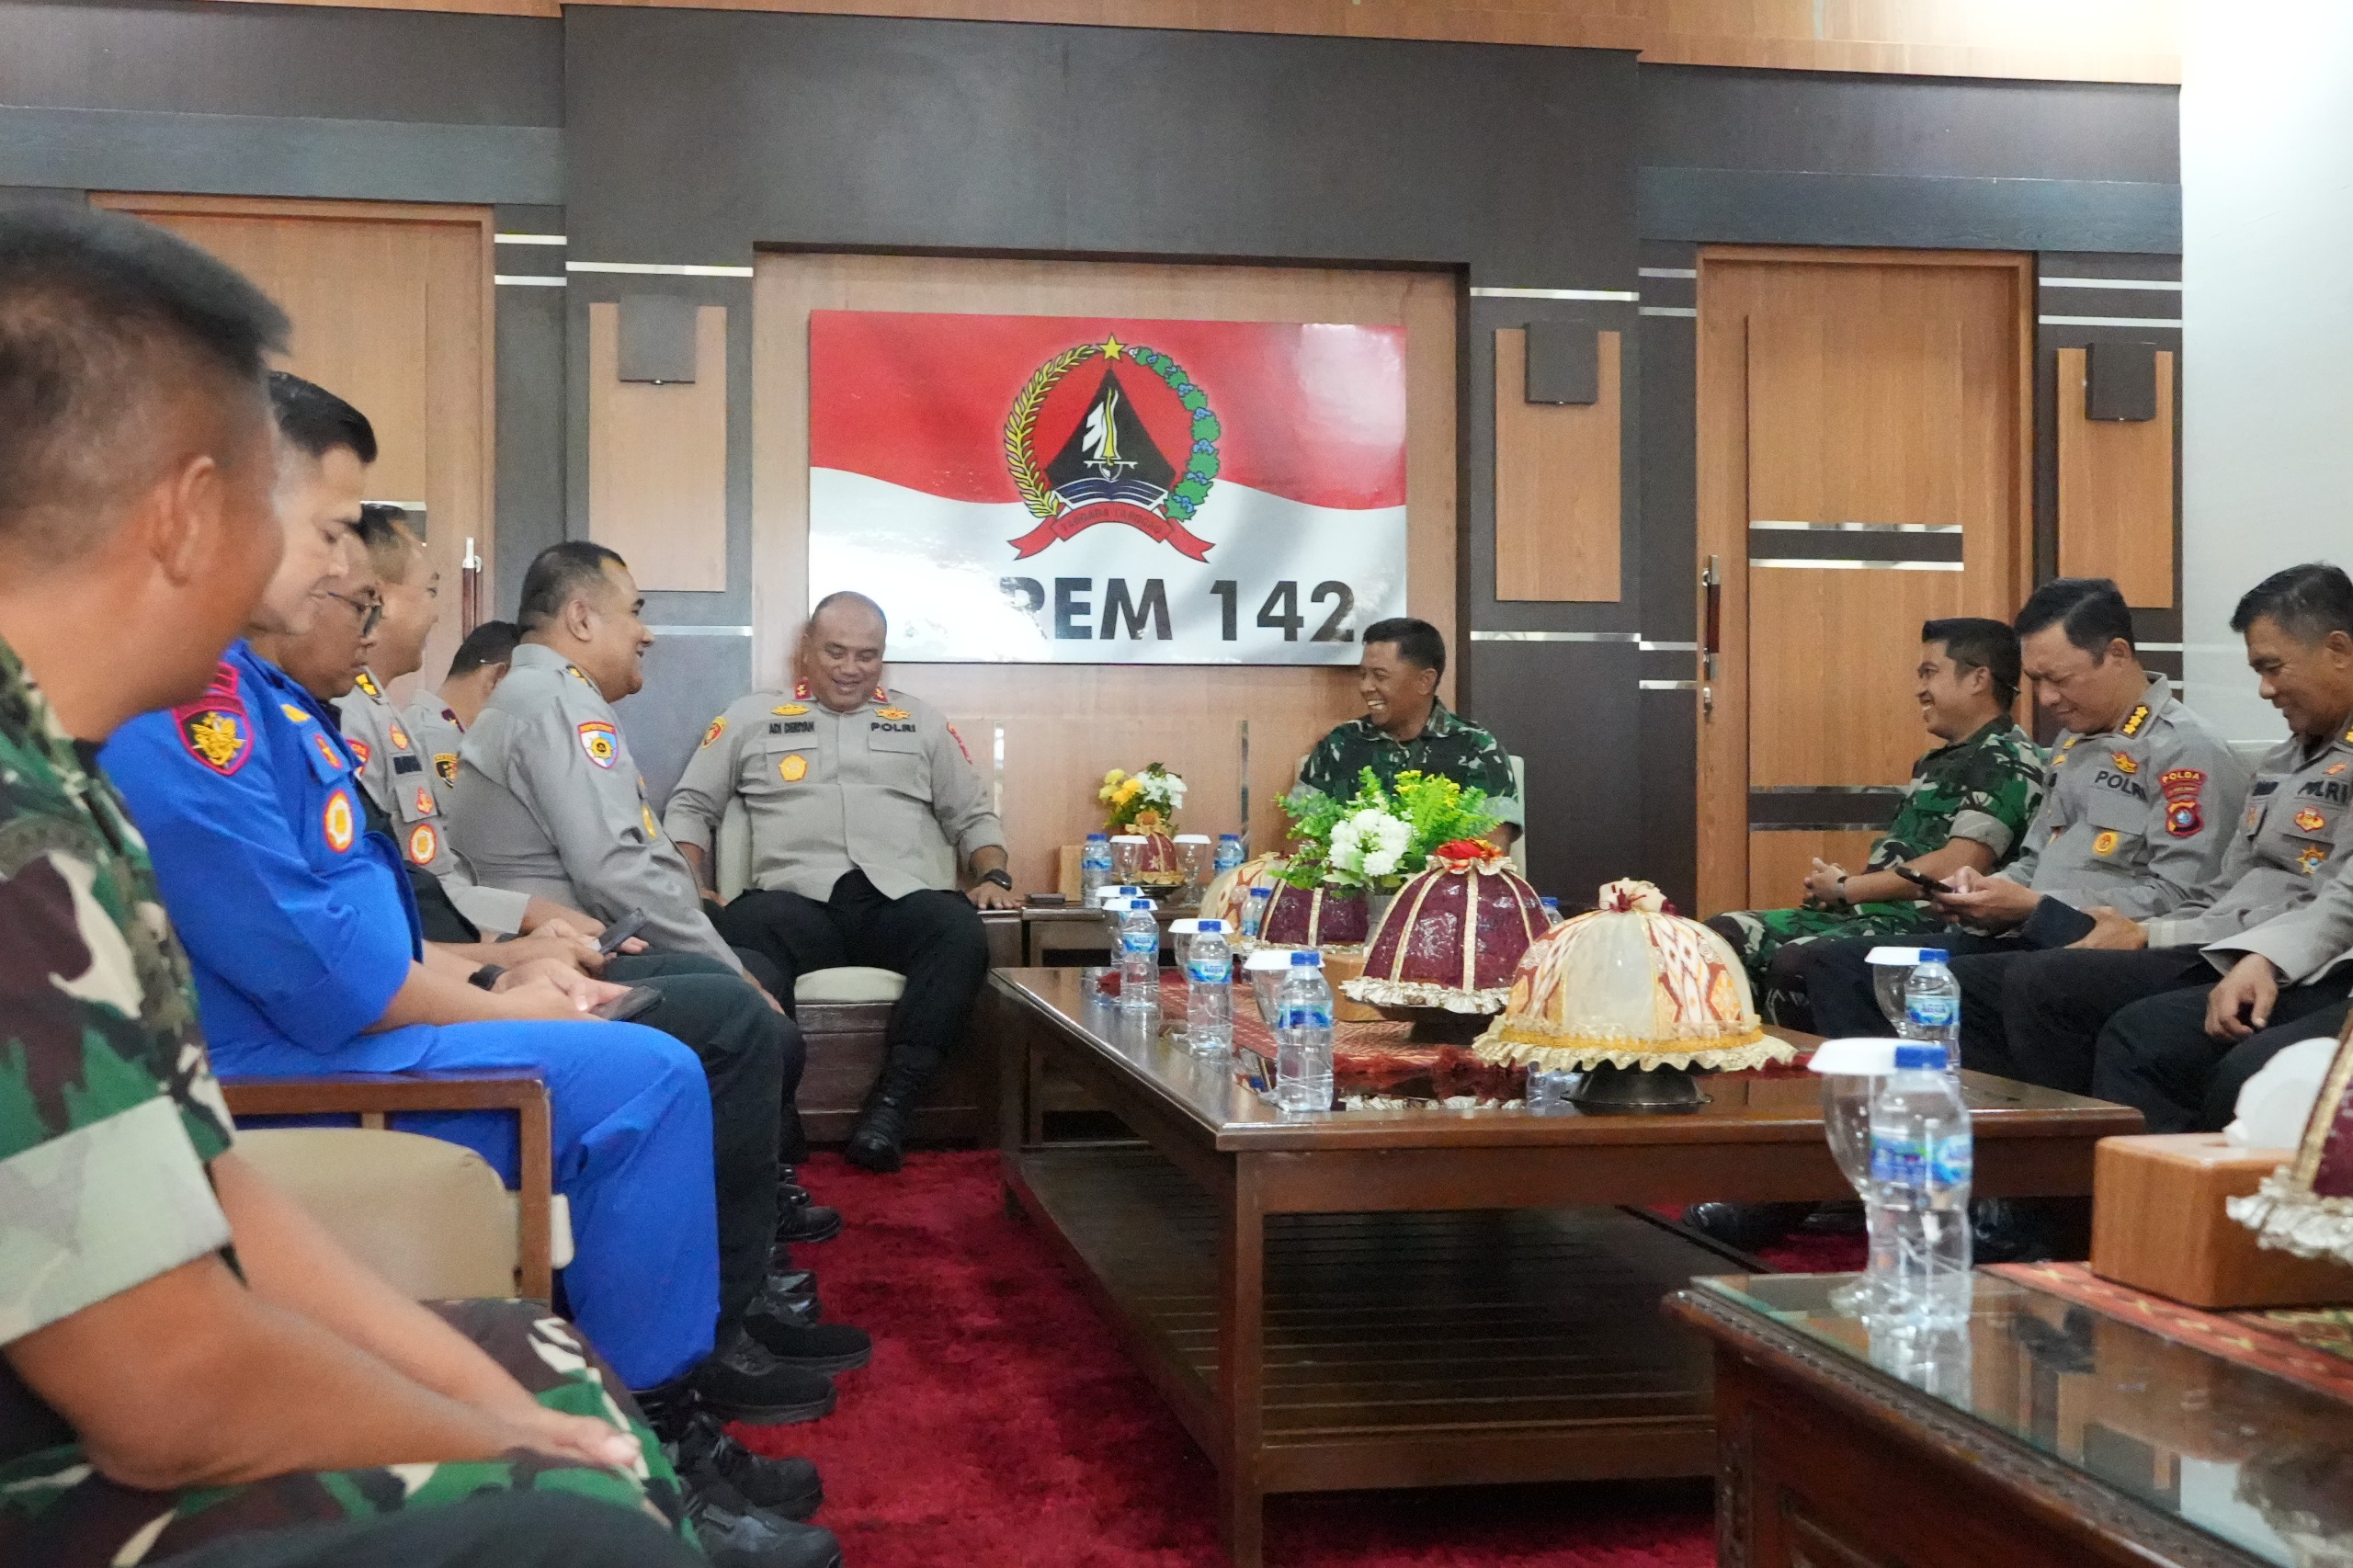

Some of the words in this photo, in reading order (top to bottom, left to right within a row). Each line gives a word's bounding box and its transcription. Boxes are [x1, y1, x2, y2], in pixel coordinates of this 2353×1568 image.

[1209, 580, 1354, 642] 142
[870, 722, 916, 733] POLRI
[2094, 770, 2148, 802] POLRI
[2162, 771, 2200, 783] POLDA
